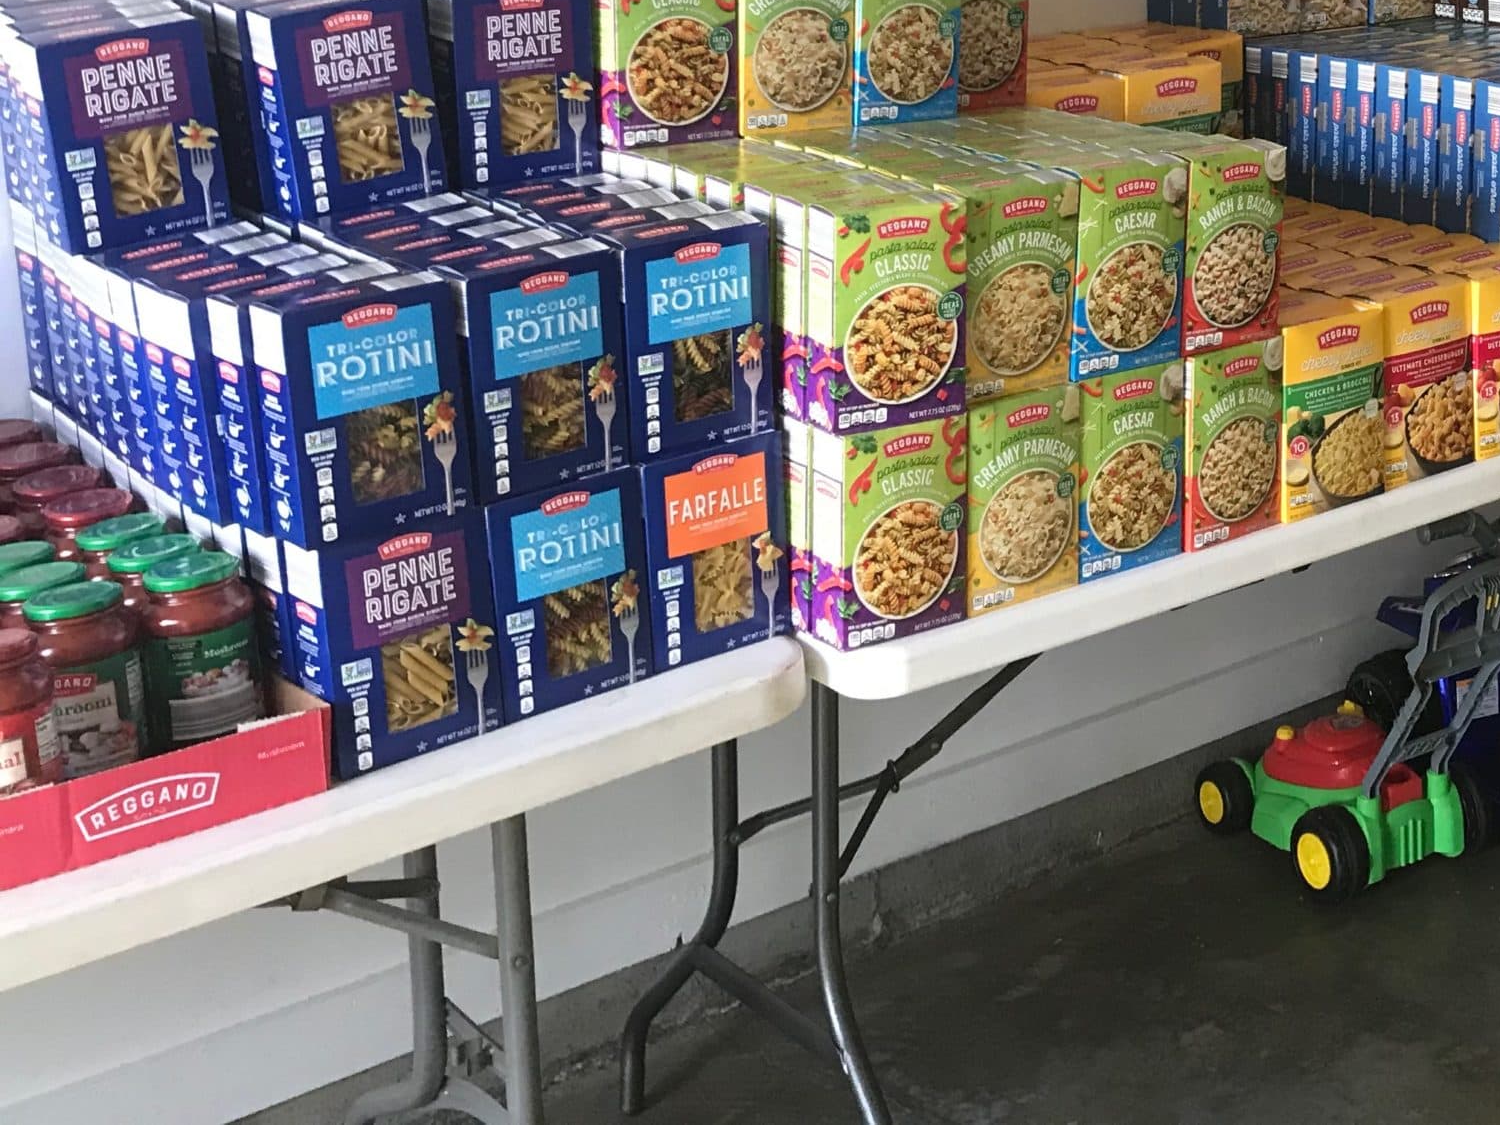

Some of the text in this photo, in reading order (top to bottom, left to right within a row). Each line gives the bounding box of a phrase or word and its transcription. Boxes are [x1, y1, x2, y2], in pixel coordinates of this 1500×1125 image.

[327, 13, 369, 27] REGGANO
[487, 9, 562, 39] PENNE
[100, 41, 145, 56] REGGANO
[311, 26, 395, 63] PENNE
[488, 33, 563, 61] RIGATE
[81, 53, 172, 94] PENNE
[314, 50, 398, 87] RIGATE
[1159, 79, 1196, 93] REGGANO
[85, 79, 178, 118] RIGATE
[1225, 165, 1259, 178] REGGANO
[1118, 181, 1156, 195] REGGANO
[1005, 199, 1046, 214] REGGANO
[1199, 194, 1277, 230] RANCH & BACON
[881, 219, 929, 235] REGGANO
[1114, 212, 1157, 234] CAESAR
[679, 245, 718, 259] REGGANO
[870, 239, 937, 263] pasta salad
[968, 231, 1073, 277] CREAMY PARMESAN
[660, 264, 738, 289] TRI-COLOR
[875, 254, 932, 278] CLASSIC
[524, 275, 566, 290] REGGANO
[505, 293, 586, 322] TRI-COLOR
[650, 276, 749, 317] ROTINI
[347, 307, 394, 323] REGGANO
[1413, 304, 1448, 321] REGGANO
[495, 305, 599, 350] ROTINI
[1320, 327, 1359, 345] REGGANO
[326, 328, 418, 357] TRI-COLOR
[316, 339, 434, 388] ROTINI
[1226, 359, 1258, 374] REGGANO
[1391, 348, 1465, 374] ULTIMATE CHEESEBURGER
[1116, 381, 1154, 396] REGGANO
[1304, 386, 1334, 399] CHICKEN
[1342, 375, 1371, 389] BROCCOLI
[1009, 406, 1048, 423] REGGANO
[1201, 387, 1275, 426] RANCH & BACON
[1113, 411, 1154, 435] CAESAR
[887, 435, 931, 453] REGGANO
[1292, 441, 1305, 453] 10
[697, 456, 735, 472] REGGANO
[876, 454, 940, 481] pasta salad
[973, 437, 1077, 489] CREAMY PARMESAN
[882, 469, 935, 496] CLASSIC
[546, 494, 587, 511] REGGANO
[669, 477, 764, 526] FARFALLE
[383, 535, 428, 555] REGGANO
[518, 522, 621, 572] ROTINI
[363, 547, 454, 598] PENNE
[365, 575, 456, 624] RIGATE
[90, 780, 208, 831] REGGANO
